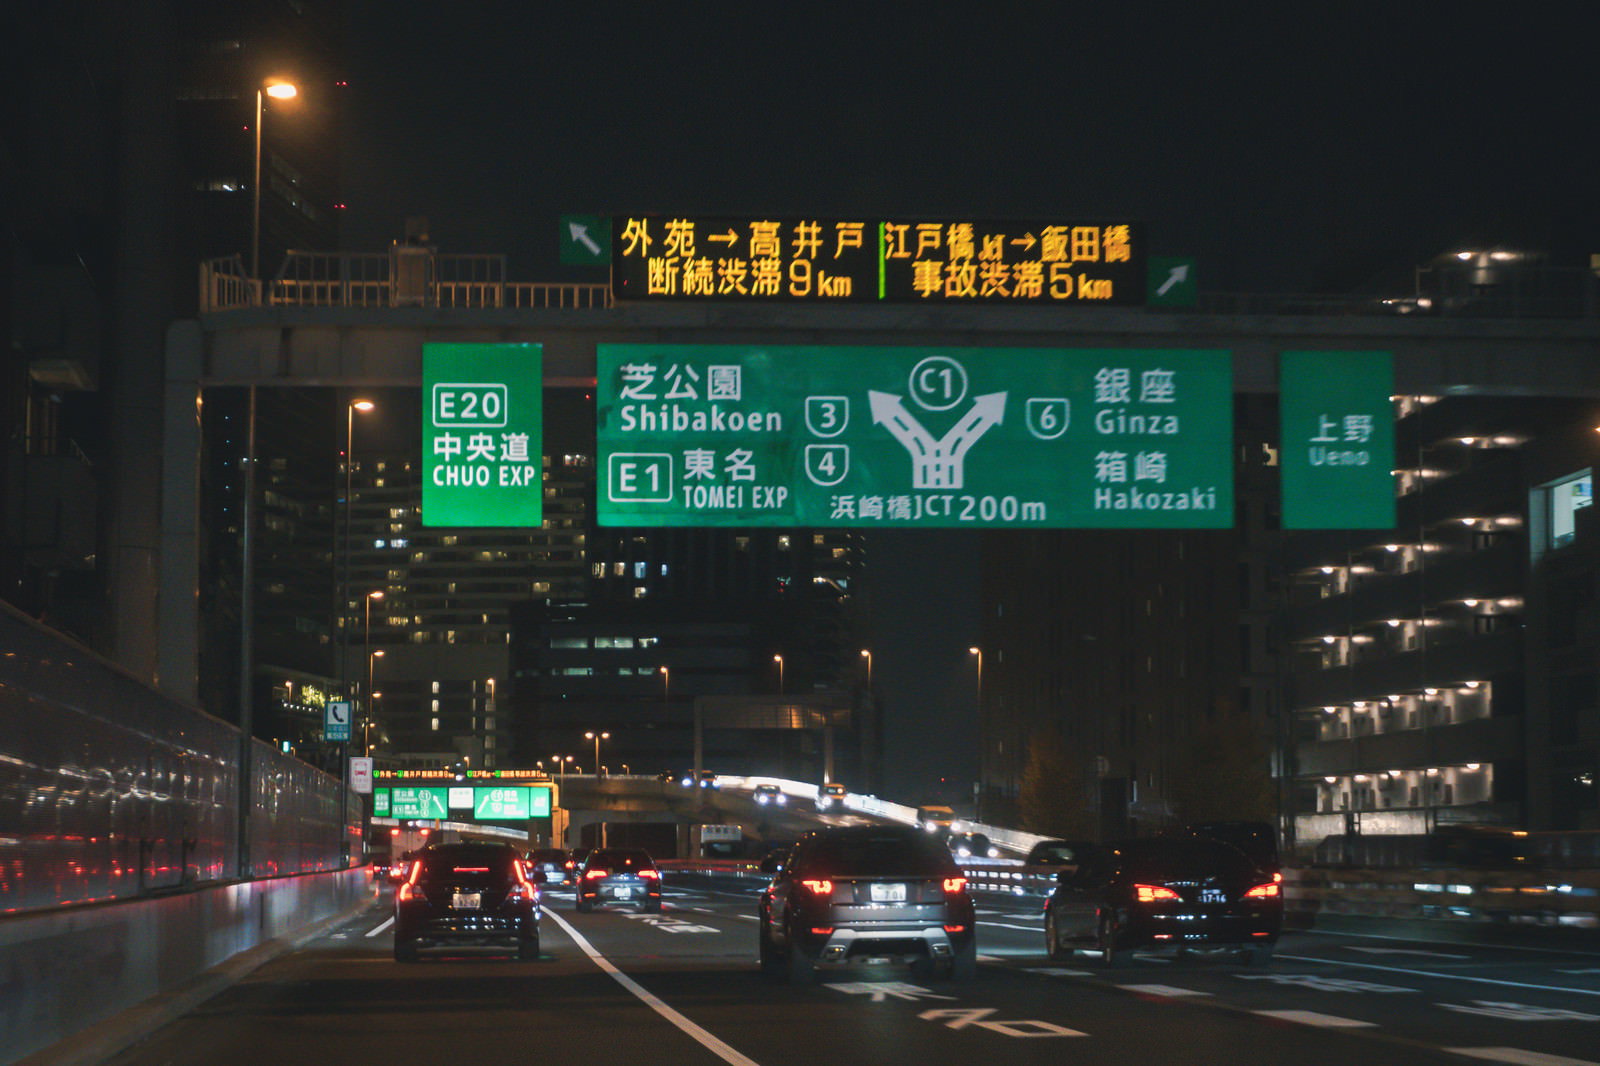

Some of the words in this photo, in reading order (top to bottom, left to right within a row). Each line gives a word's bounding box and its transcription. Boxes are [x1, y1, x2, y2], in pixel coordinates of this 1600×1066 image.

[621, 218, 695, 257] 外苑
[749, 220, 864, 259] 高井戸
[1040, 225, 1130, 263] 飯田橋
[620, 363, 741, 400] 芝公園
[919, 368, 952, 399] C1
[1095, 368, 1174, 403] 銀座
[441, 392, 499, 418] E20
[622, 404, 781, 431] Shibakoen
[821, 403, 835, 427] 3
[1041, 405, 1056, 429] 6
[1096, 409, 1178, 434] Ginza
[1309, 415, 1374, 443] 上野
[434, 432, 528, 461] 中央道
[1310, 447, 1368, 465] Ueno
[433, 465, 489, 486] CHUO
[500, 466, 534, 486] EXP
[684, 448, 755, 481] 東名
[819, 452, 835, 475] 4
[1096, 451, 1166, 483] 箱崎
[621, 464, 658, 491] E1
[683, 486, 742, 508] TOMEI
[753, 486, 787, 508] EXP
[1095, 487, 1214, 509] Hakozaki
